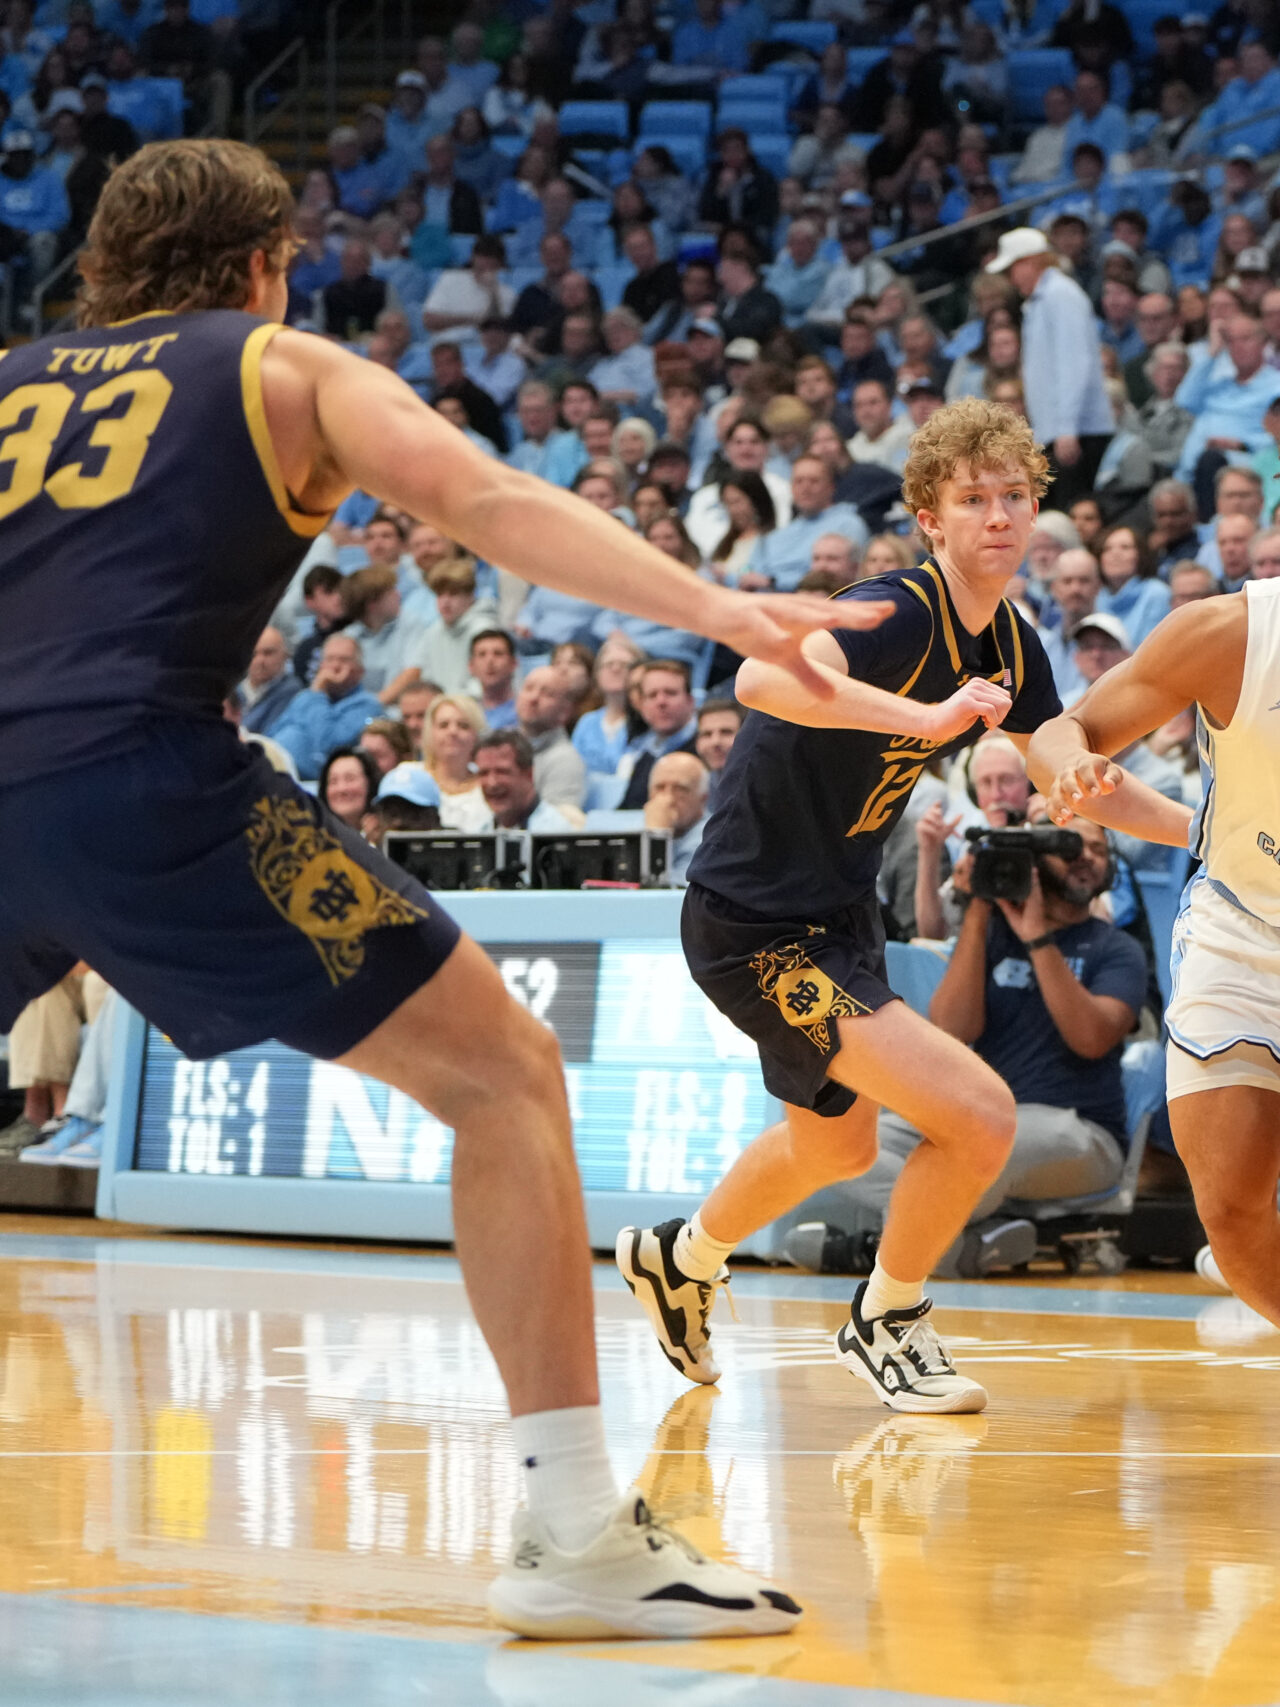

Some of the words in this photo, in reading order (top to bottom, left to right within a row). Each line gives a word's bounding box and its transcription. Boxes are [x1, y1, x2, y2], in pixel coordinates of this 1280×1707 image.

[46, 332, 179, 374] TOWT
[0, 368, 174, 521] 33
[845, 763, 925, 838] 12
[171, 1059, 242, 1118] FLS:
[244, 1061, 271, 1118] 4
[168, 1118, 237, 1175] TOL:
[247, 1120, 267, 1177] 1
